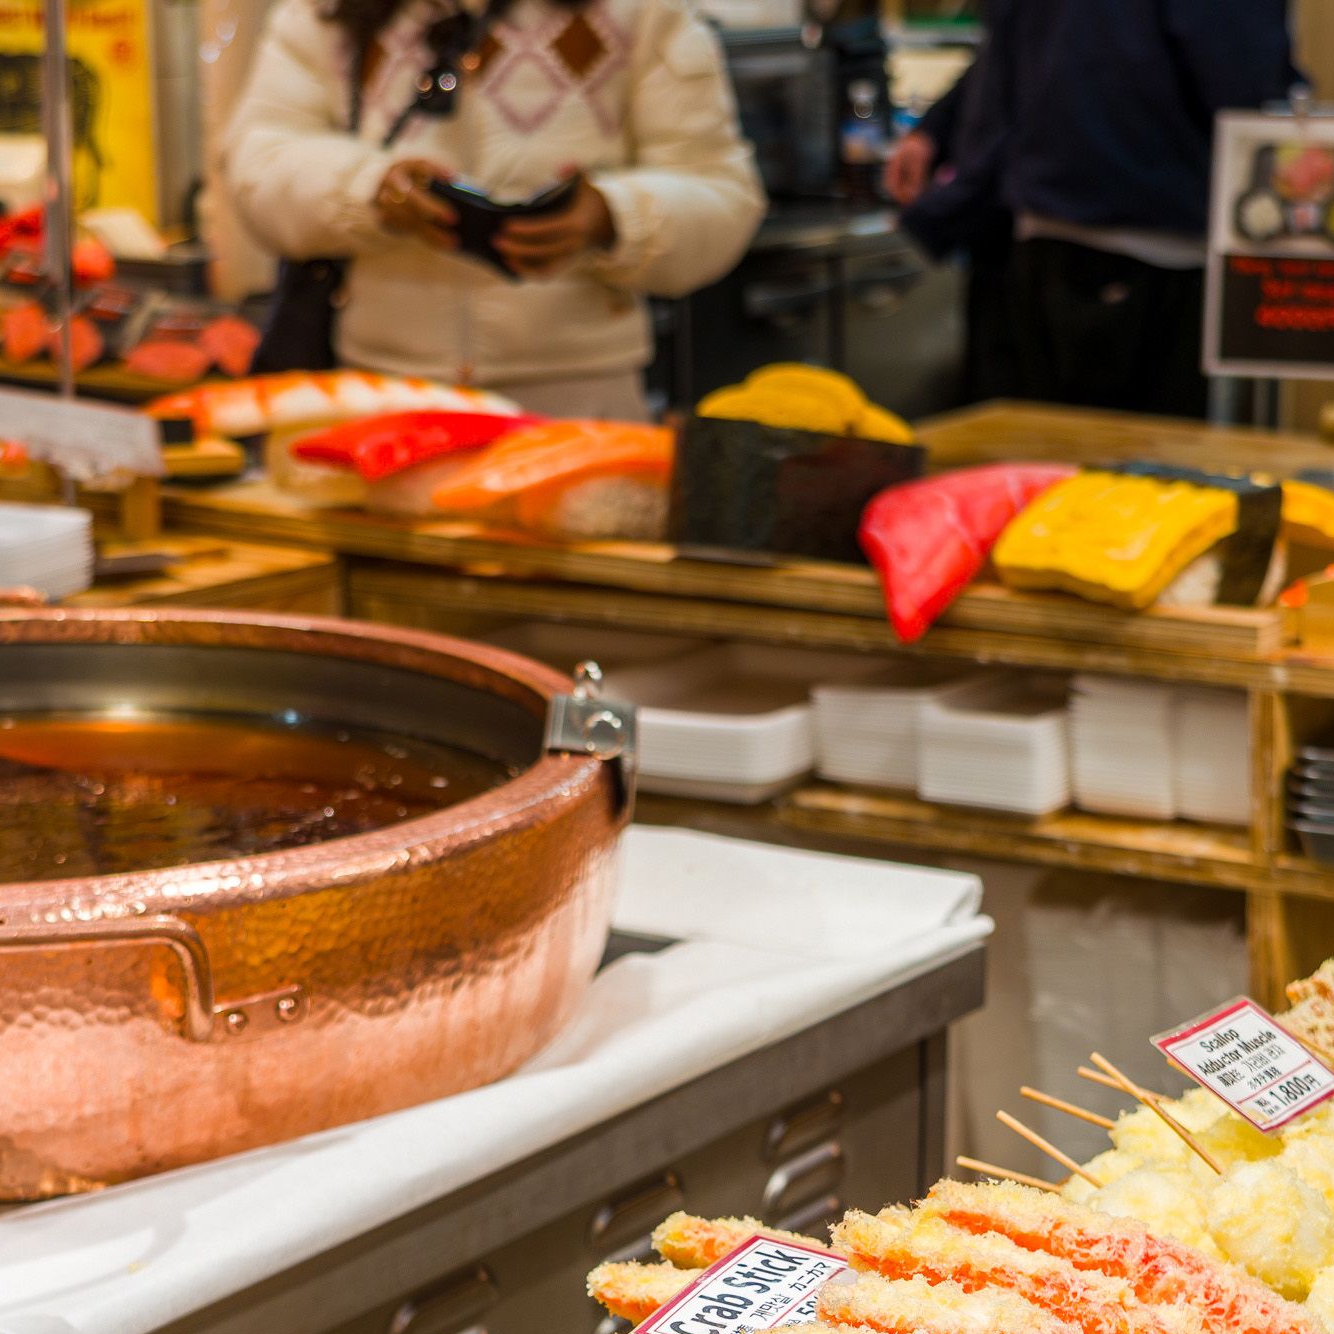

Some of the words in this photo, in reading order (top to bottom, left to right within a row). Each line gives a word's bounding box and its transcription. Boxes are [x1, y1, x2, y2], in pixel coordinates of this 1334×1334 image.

[1196, 1049, 1240, 1077] Adductor
[1237, 1028, 1277, 1056] Muscle
[1199, 1028, 1239, 1053] Scallop
[1269, 1074, 1321, 1107] 1,800円
[722, 1248, 810, 1295] Stick
[749, 1293, 793, 1321] 게맛살
[787, 1261, 831, 1292] カニカマ
